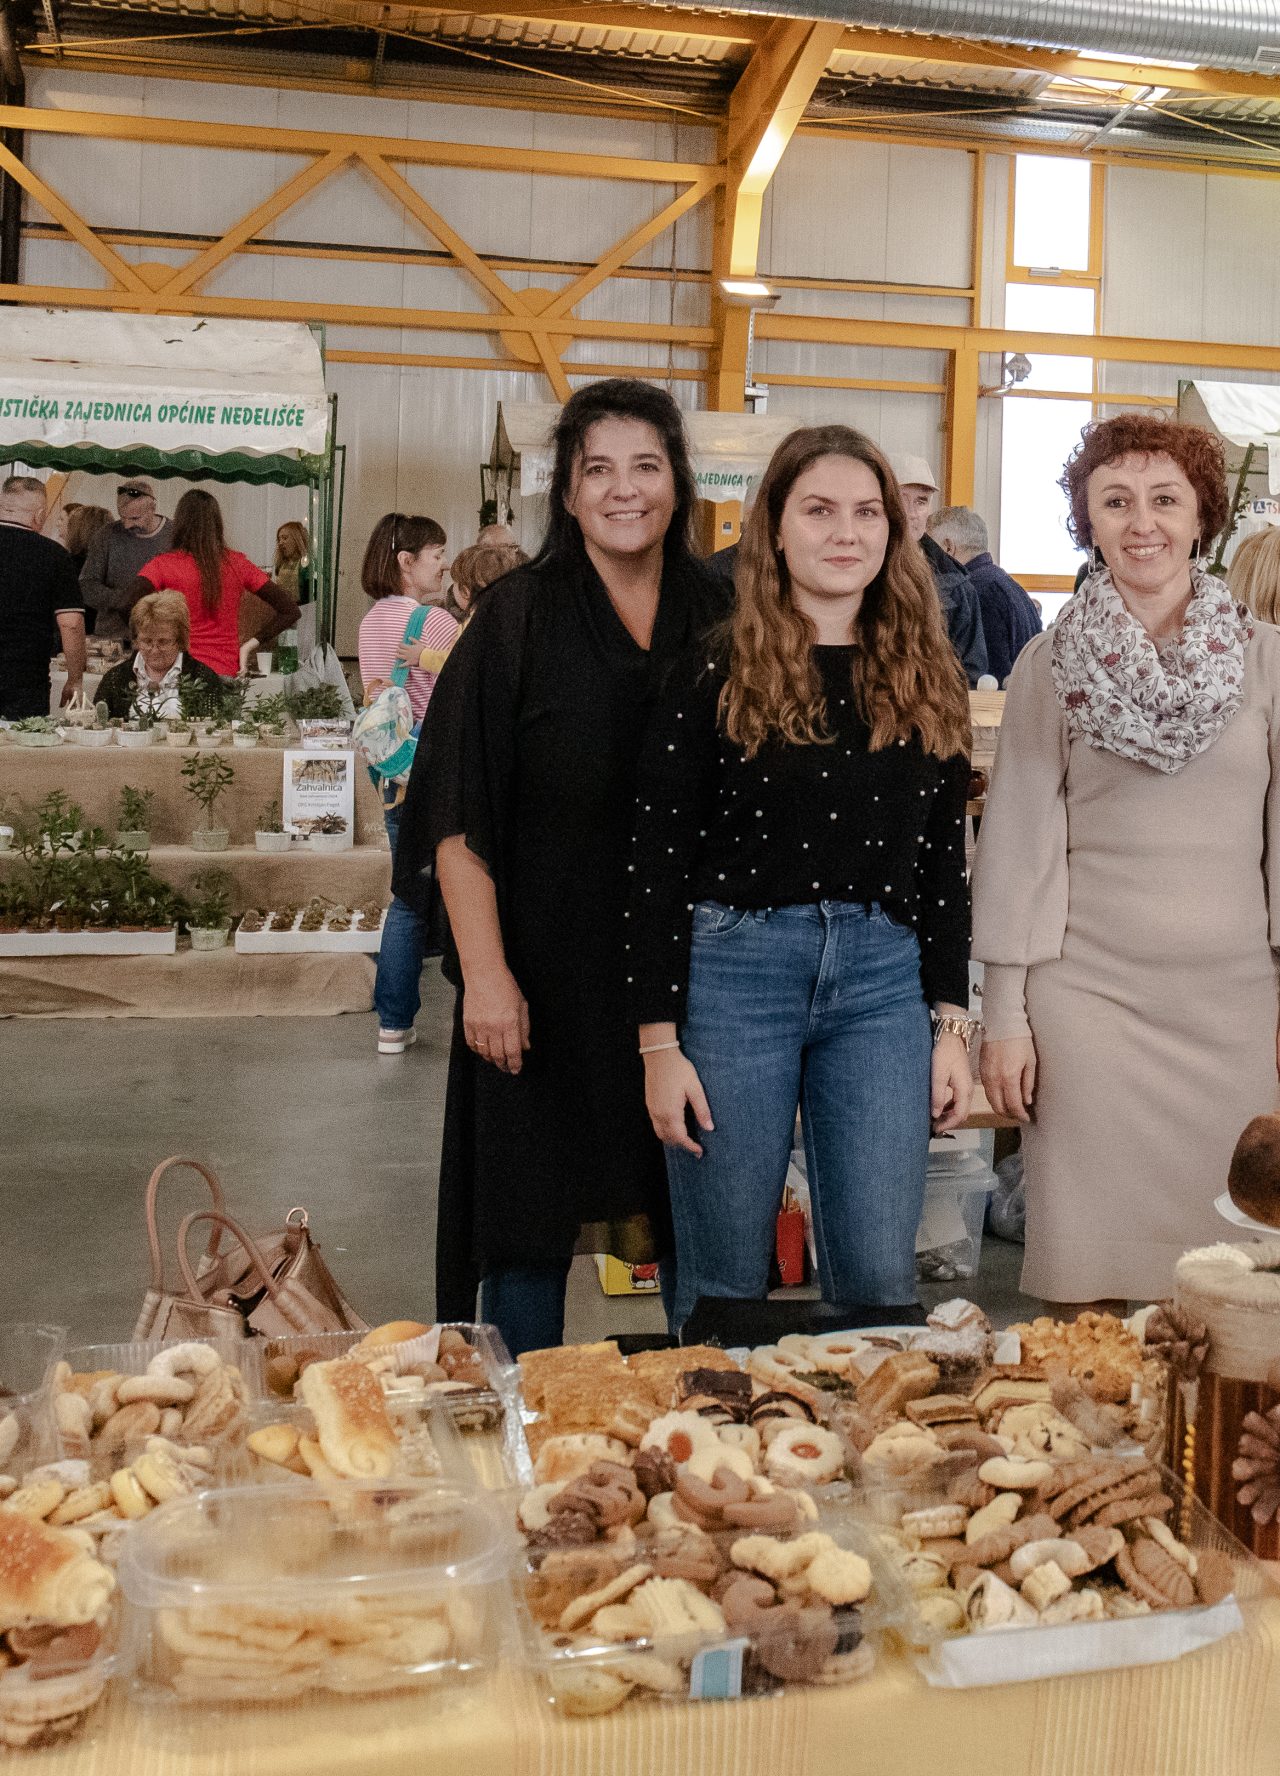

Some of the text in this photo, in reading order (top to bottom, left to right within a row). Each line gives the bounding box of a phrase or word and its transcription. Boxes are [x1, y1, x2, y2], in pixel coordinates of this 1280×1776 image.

[64, 400, 152, 422] ZAJEDNICA
[157, 400, 216, 424] OPĆINE
[220, 404, 305, 427] NEDELIŠĆE
[695, 472, 743, 487] AJEDNICA
[296, 783, 342, 791] Zahvalnica
